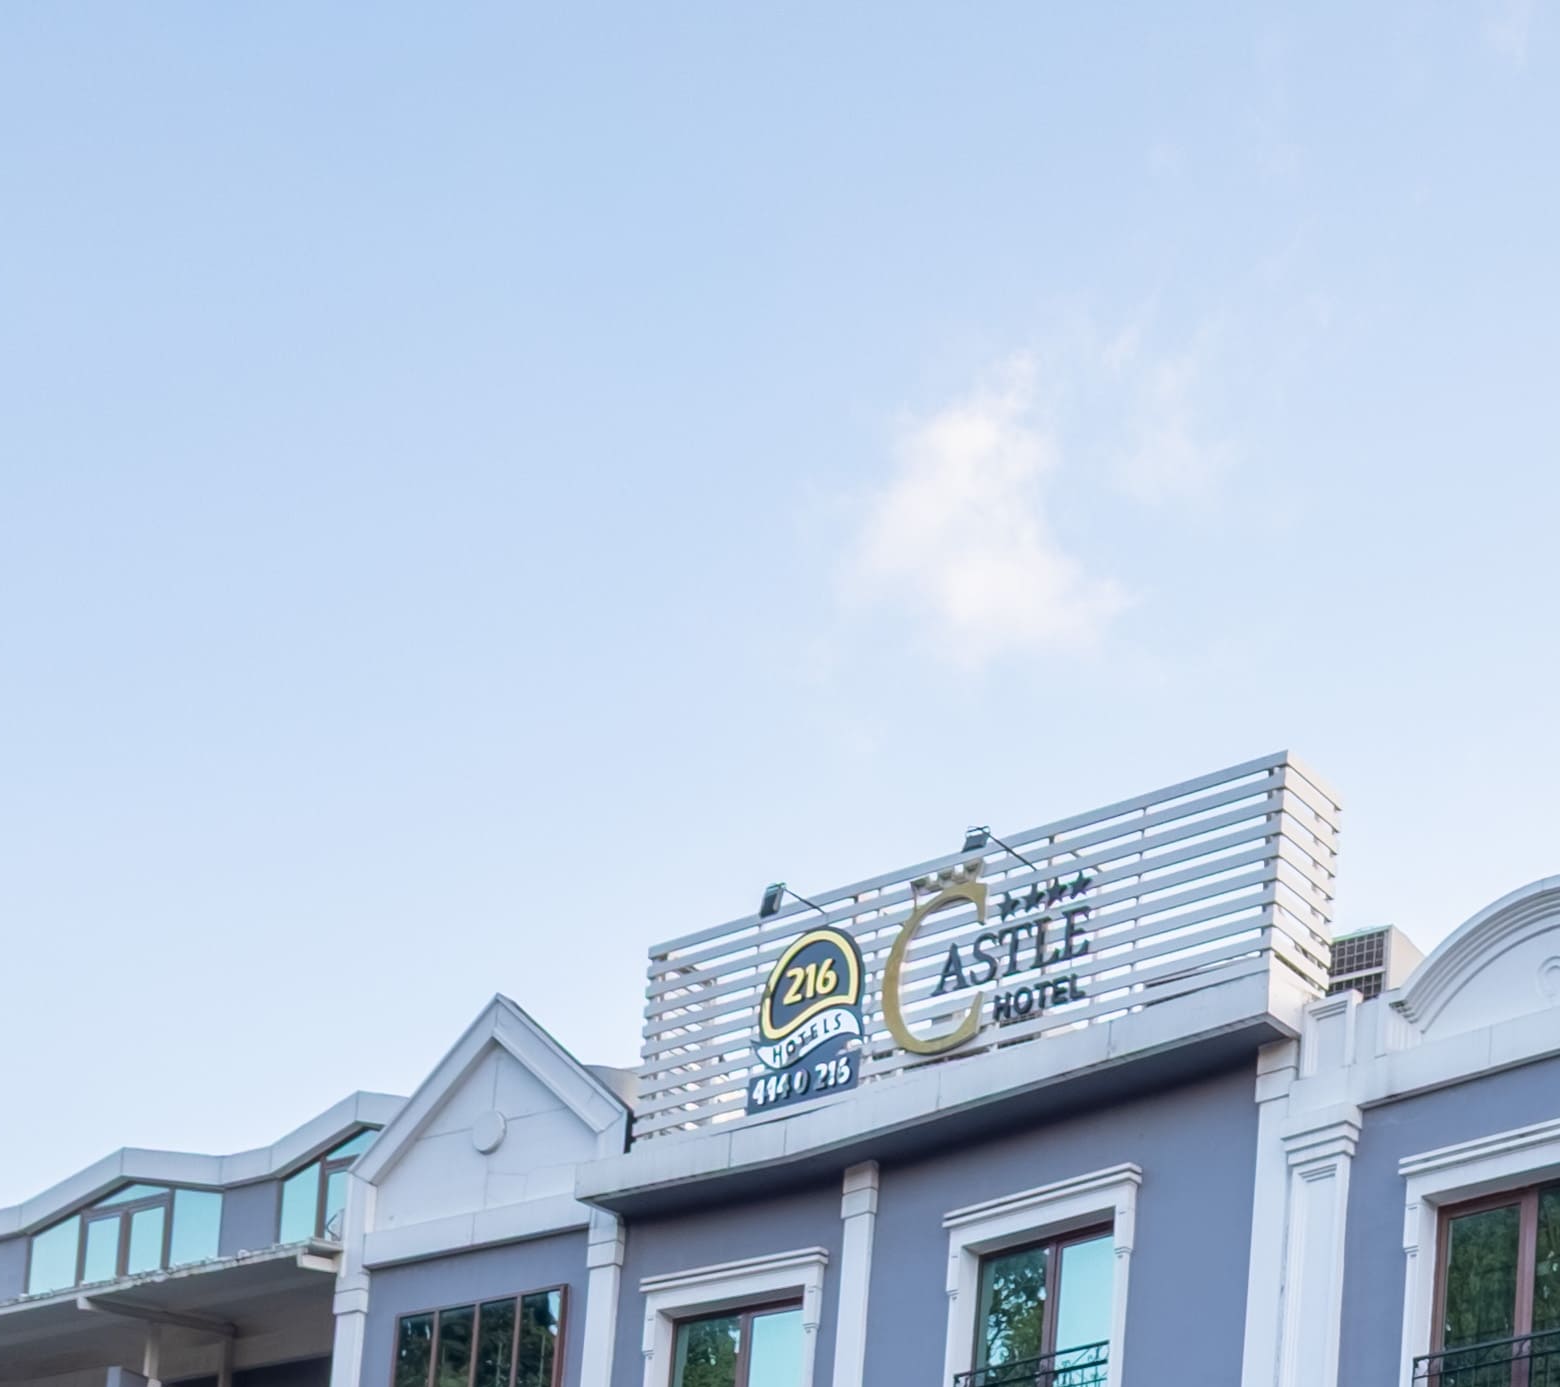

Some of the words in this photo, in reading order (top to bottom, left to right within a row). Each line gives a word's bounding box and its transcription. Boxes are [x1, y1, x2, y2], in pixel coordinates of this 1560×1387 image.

[783, 958, 839, 1006] 216
[993, 973, 1086, 1022] HOTEL
[772, 1012, 842, 1064] HOTELS
[815, 1057, 852, 1091] 216
